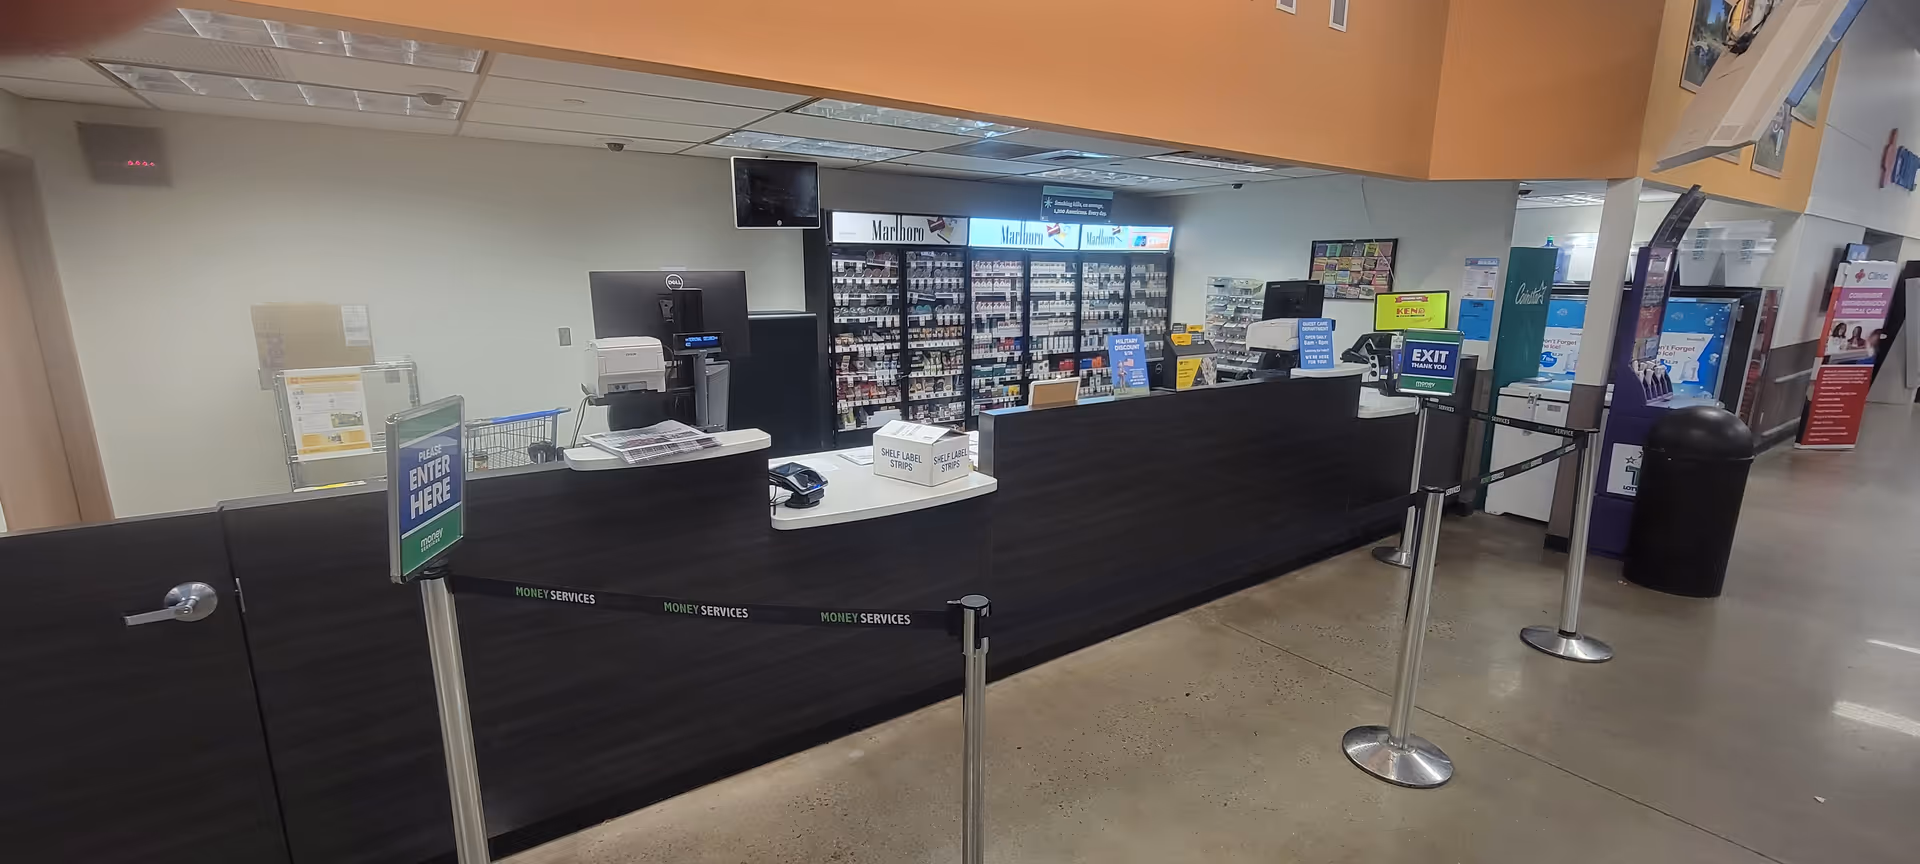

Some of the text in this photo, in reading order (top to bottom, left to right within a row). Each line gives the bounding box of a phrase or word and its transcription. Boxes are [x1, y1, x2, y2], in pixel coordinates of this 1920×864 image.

[872, 215, 924, 242] Marlboro
[1000, 218, 1043, 246] Marlboro
[1087, 228, 1115, 246] Marlboro
[1868, 272, 1888, 280] Clinic
[1515, 280, 1547, 304] Coinstar
[1396, 307, 1425, 315] KENO
[1412, 348, 1449, 363] EXIT
[1671, 345, 1695, 353] Forget
[1491, 416, 1510, 424] SERVICES
[418, 444, 442, 462] PLEASE
[881, 447, 922, 463] SHELF LABEL
[934, 448, 968, 465] SHELF LABEL
[409, 454, 450, 491] ENTER
[890, 460, 913, 471] STRIPS
[941, 460, 960, 472] STRIPS
[410, 476, 451, 520] HERE
[421, 528, 443, 547] money
[515, 586, 596, 605] MONEY SERVICES
[664, 601, 749, 619] MONEY SERVICES
[820, 612, 911, 625] MONEY SERVICES
